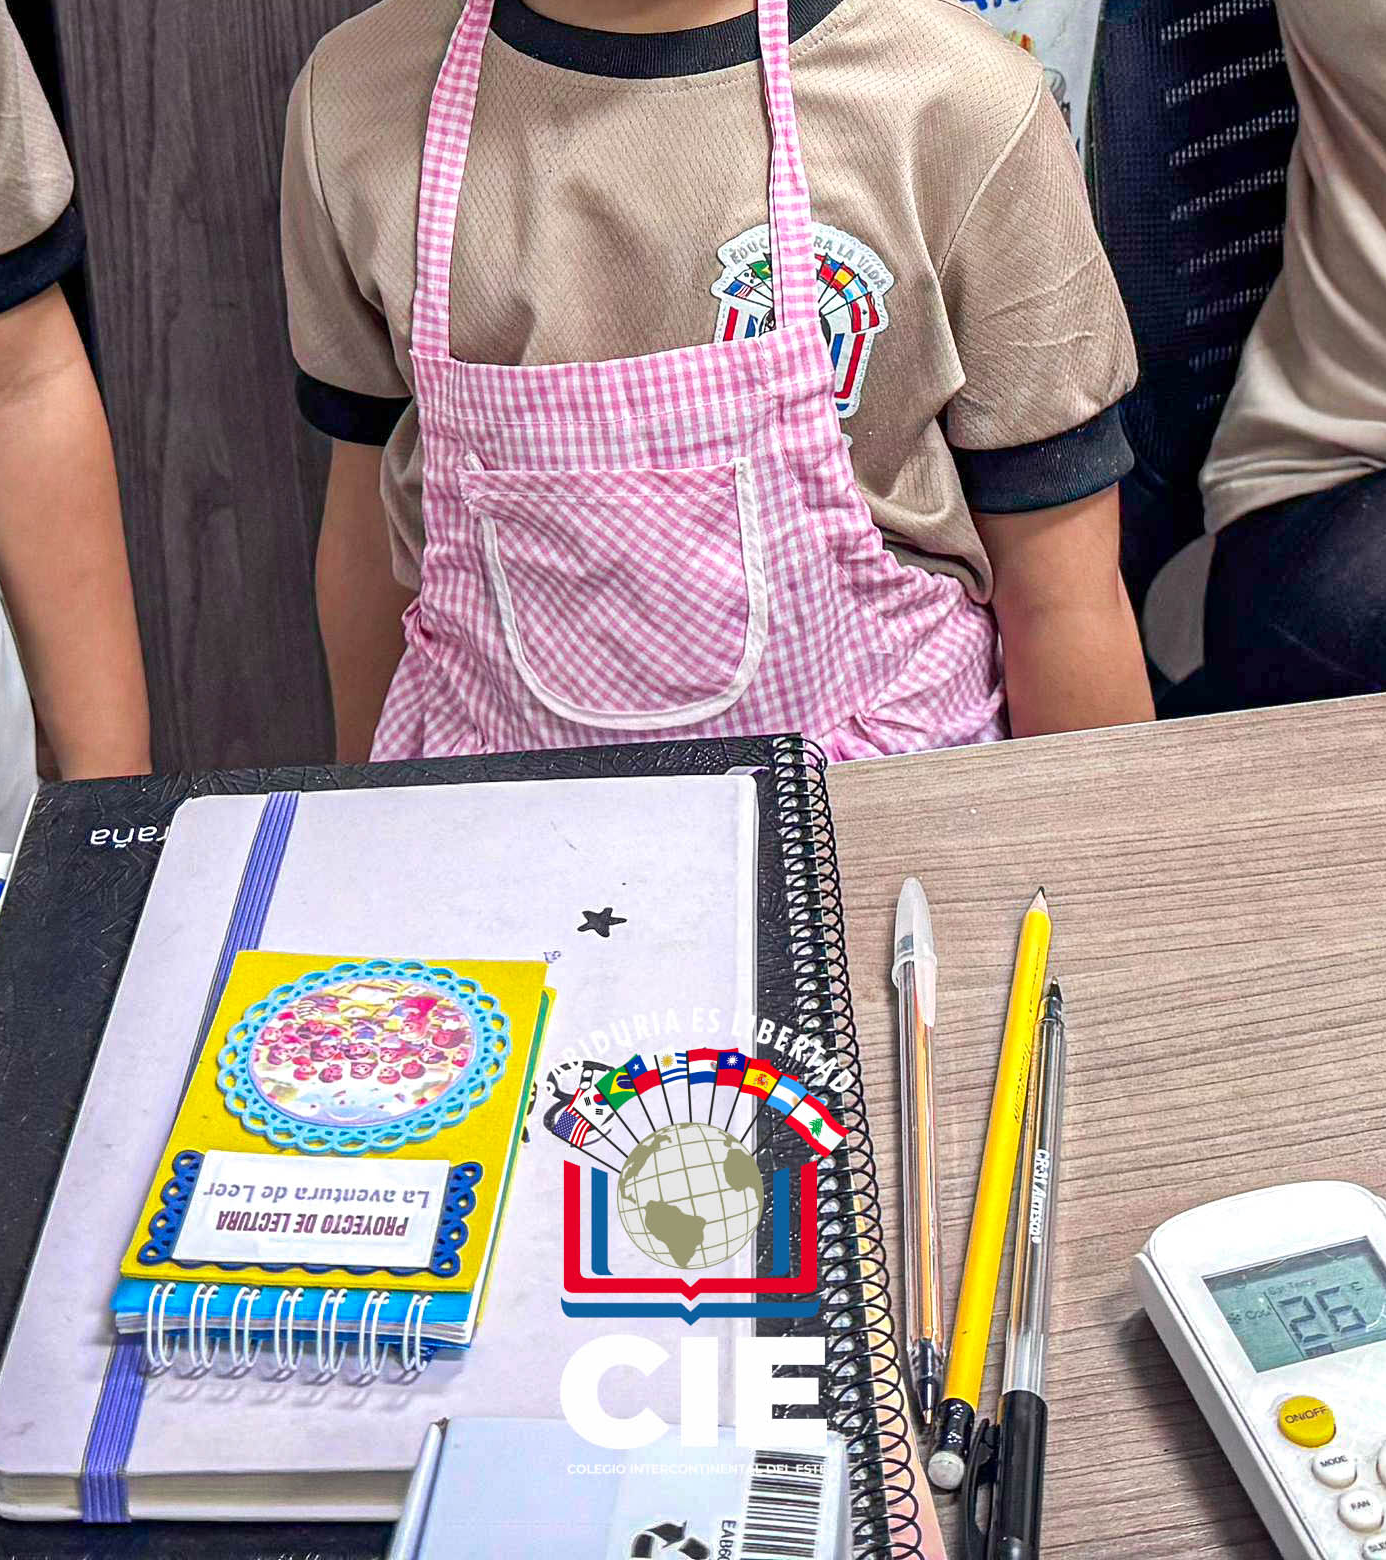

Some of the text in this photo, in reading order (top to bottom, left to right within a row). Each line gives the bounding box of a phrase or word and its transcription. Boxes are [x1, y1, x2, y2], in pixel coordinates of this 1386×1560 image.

[90, 824, 171, 850] raña
[203, 1181, 430, 1210] La aventura de Leer
[215, 1211, 407, 1237] PROYECTO DE LECTURA
[1278, 1285, 1367, 1345] 26
[1284, 1405, 1327, 1424] ON/OFF
[1320, 1454, 1348, 1468] MODE
[1351, 1500, 1371, 1512] FAN
